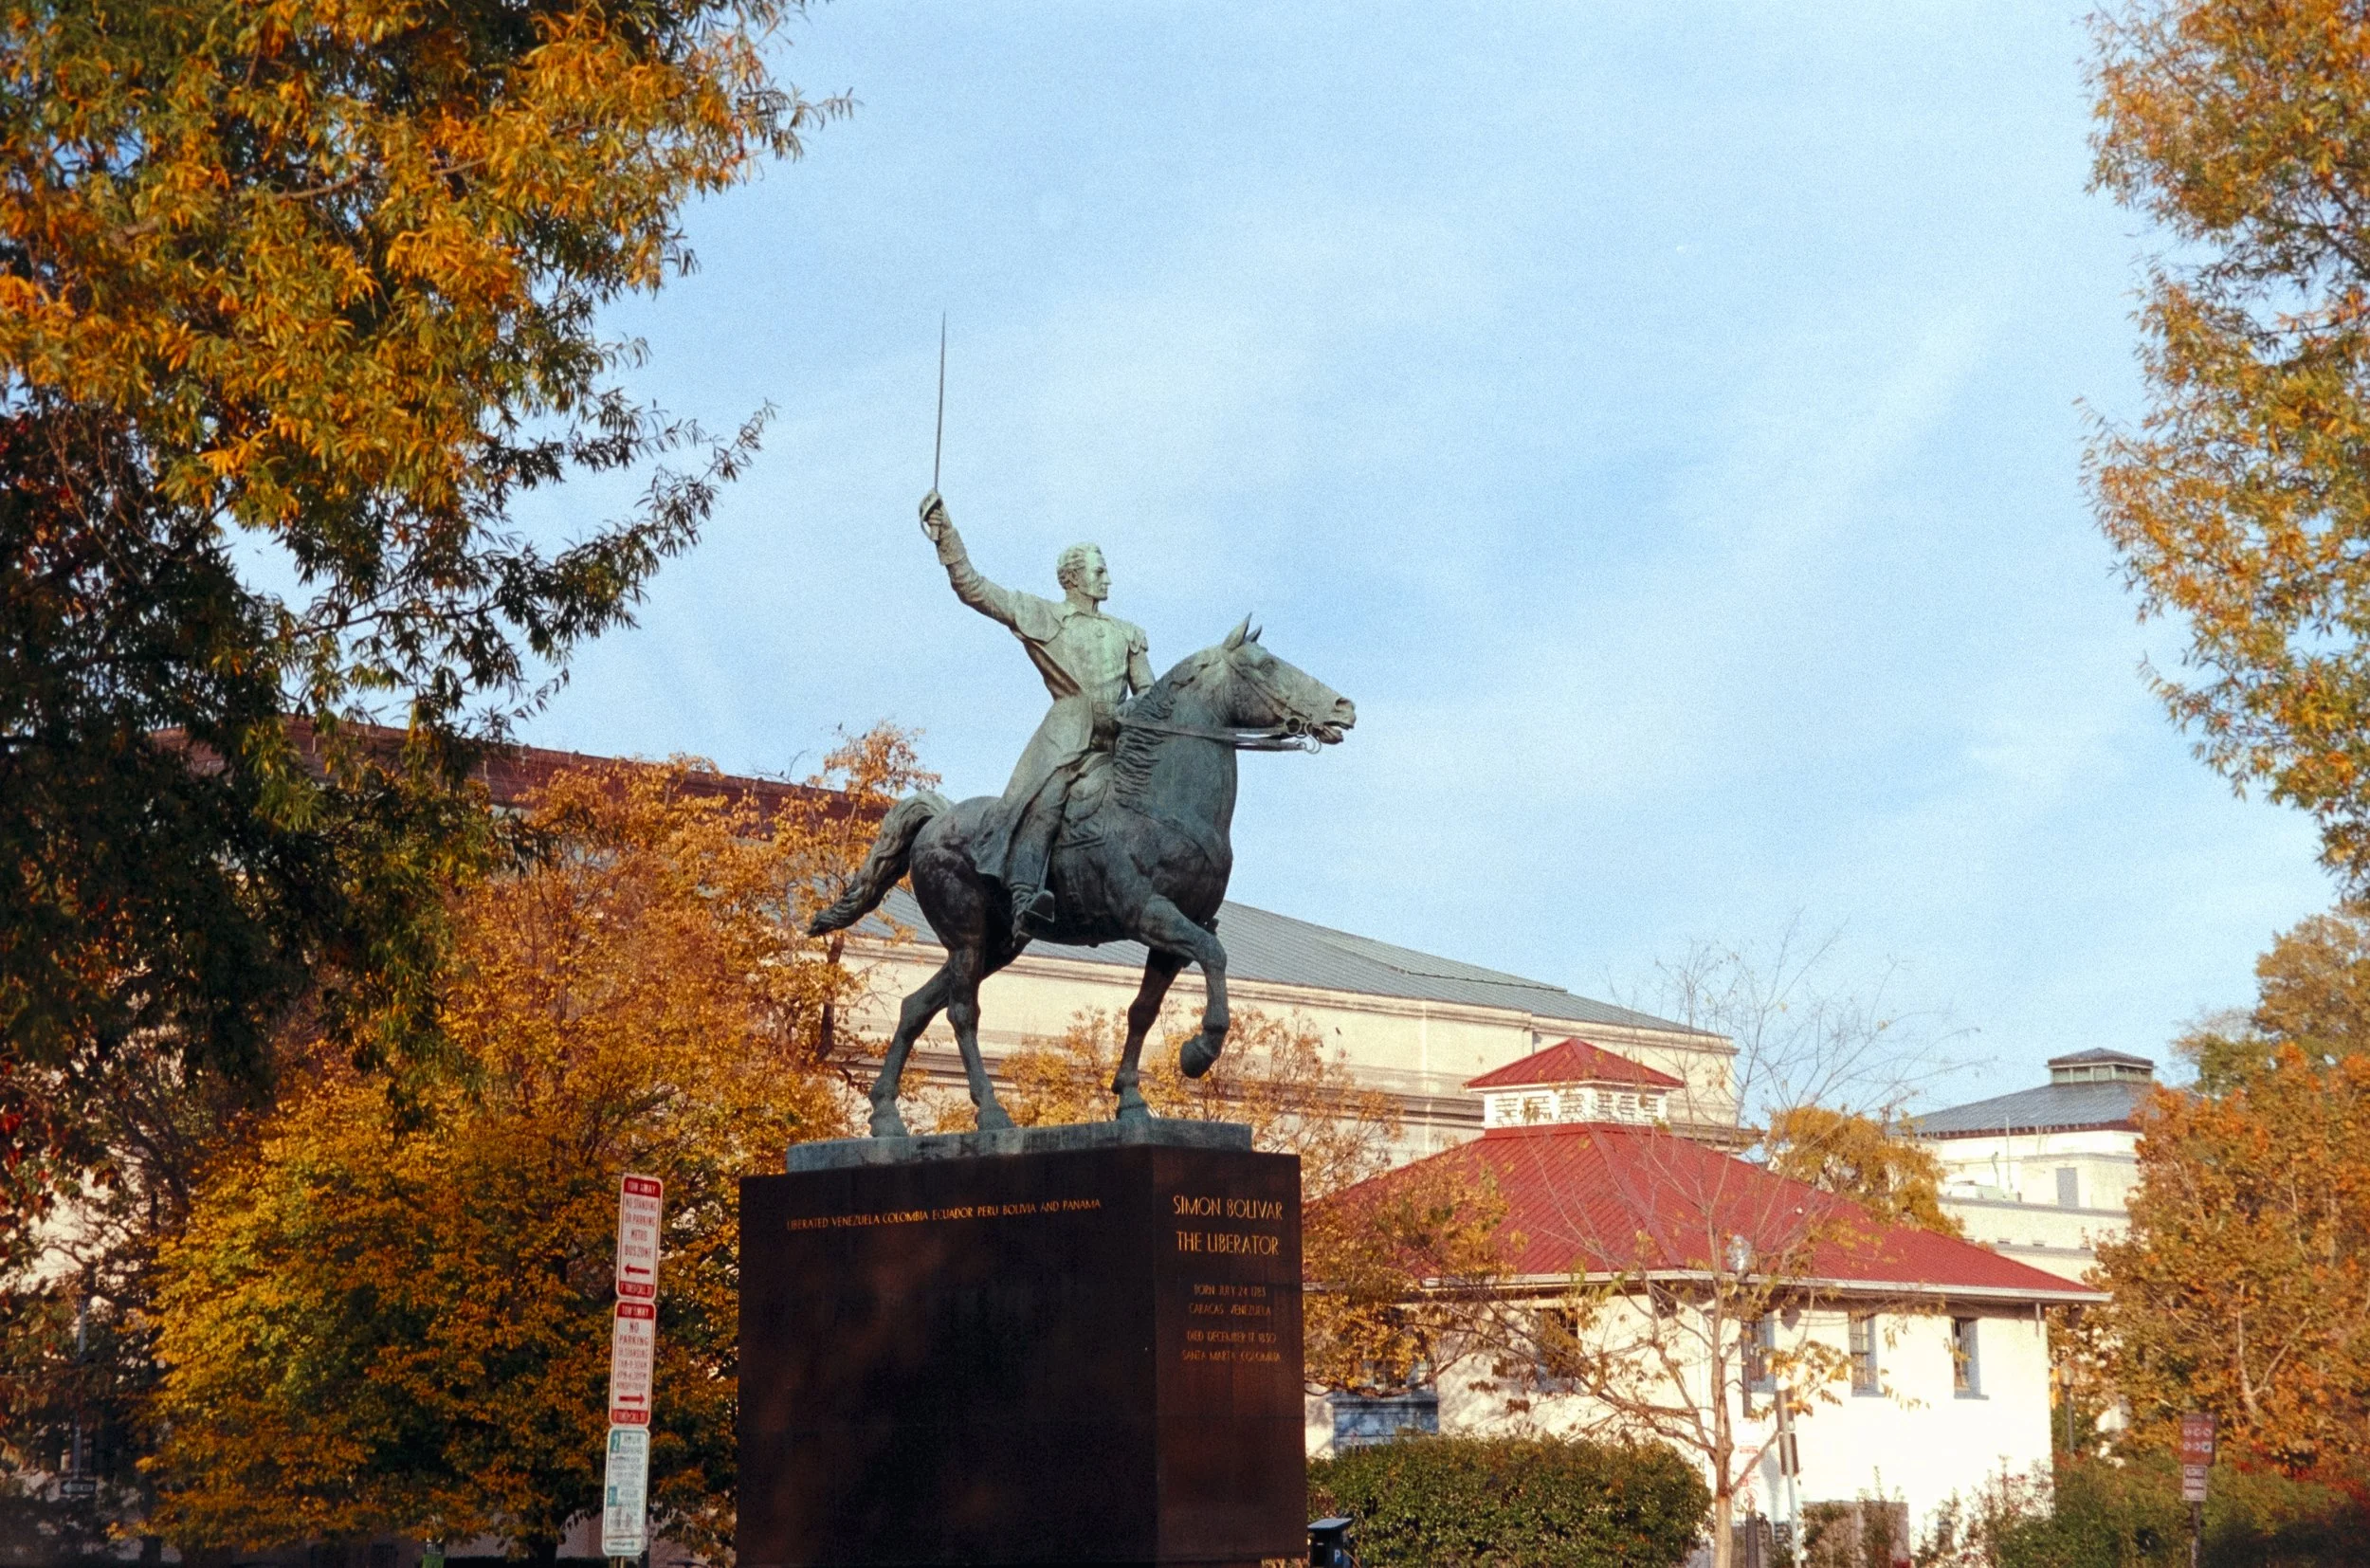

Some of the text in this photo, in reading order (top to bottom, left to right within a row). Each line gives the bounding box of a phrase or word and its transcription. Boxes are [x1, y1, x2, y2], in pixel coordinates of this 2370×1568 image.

[628, 1180, 657, 1194] TOW AWAY
[1173, 1194, 1283, 1220] SIMON BOLIVAR
[632, 1213, 655, 1227] PARKING
[787, 1198, 1102, 1231] LIBERATED VENEZUELA COLOMBIA ECUADOR PERU BOLIVIA AND PANAMA
[1176, 1231, 1280, 1255] THE LIBERATOR
[1188, 1303, 1272, 1316] CARACAS VENEZUELA
[629, 1322, 640, 1333] NO
[619, 1334, 649, 1346] PARKING
[1335, 1549, 1340, 1562] P
